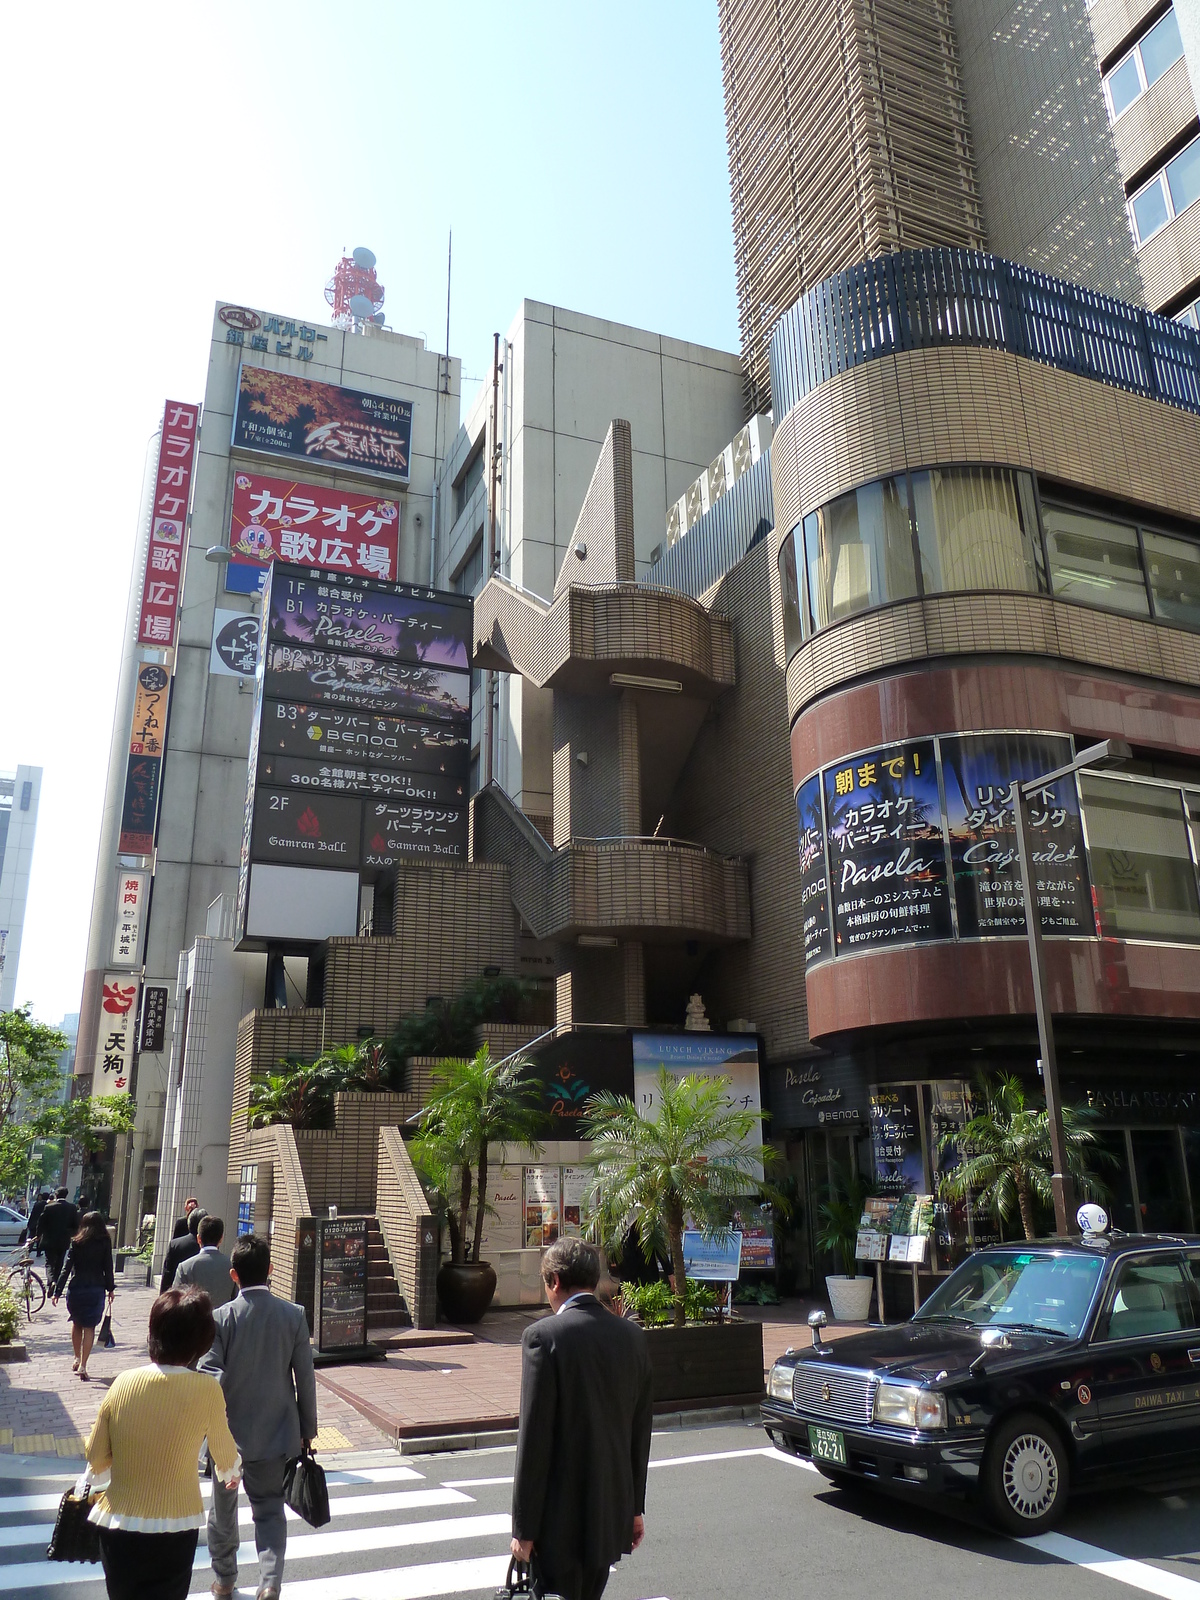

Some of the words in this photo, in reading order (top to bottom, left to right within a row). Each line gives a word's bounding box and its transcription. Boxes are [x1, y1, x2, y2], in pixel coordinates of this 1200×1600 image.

[226, 328, 314, 361] 銀座ビル
[162, 407, 195, 516] カラオケ
[249, 490, 393, 537] カラオケ
[280, 529, 393, 573] 歌広場
[142, 547, 179, 641] 歌広場
[288, 580, 306, 597] 1F
[317, 585, 364, 604] 総合受付
[310, 569, 436, 599] 銀座ウォールビル
[286, 599, 304, 615] B1
[316, 602, 443, 631] カラオケ・パーティー
[315, 616, 392, 644] Pasela
[281, 647, 304, 663] B2
[313, 654, 424, 681] リゾートダイニング
[136, 693, 161, 753] つくね十番
[277, 705, 298, 720] B3
[307, 711, 370, 727] ダーツバー
[377, 721, 387, 731] &
[395, 724, 455, 739] パーティー
[290, 774, 437, 800] 300名様パーティーOK!!
[319, 767, 412, 786] 全館朝までOK!!
[835, 753, 921, 795] 朝まで!
[269, 796, 289, 811] 2F
[978, 786, 1055, 805] リゾト
[375, 804, 459, 823] ダーツラウンジ
[845, 797, 913, 829] カラオケ
[386, 820, 447, 836] パーティー
[839, 823, 926, 853] パーティー
[840, 847, 935, 893] Pasela
[123, 880, 139, 904] 焼肉
[979, 880, 1075, 892] 滝の音をきながら
[846, 903, 931, 928] 本格厨房の旬鮮料理
[102, 1032, 126, 1074] 天狗
[659, 1045, 692, 1053] LUNCH
[786, 1065, 821, 1088] Pasela
[1134, 1394, 1163, 1408] DAIWA
[1165, 1390, 1185, 1404] TAXI
[817, 1439, 844, 1462] 62-21
